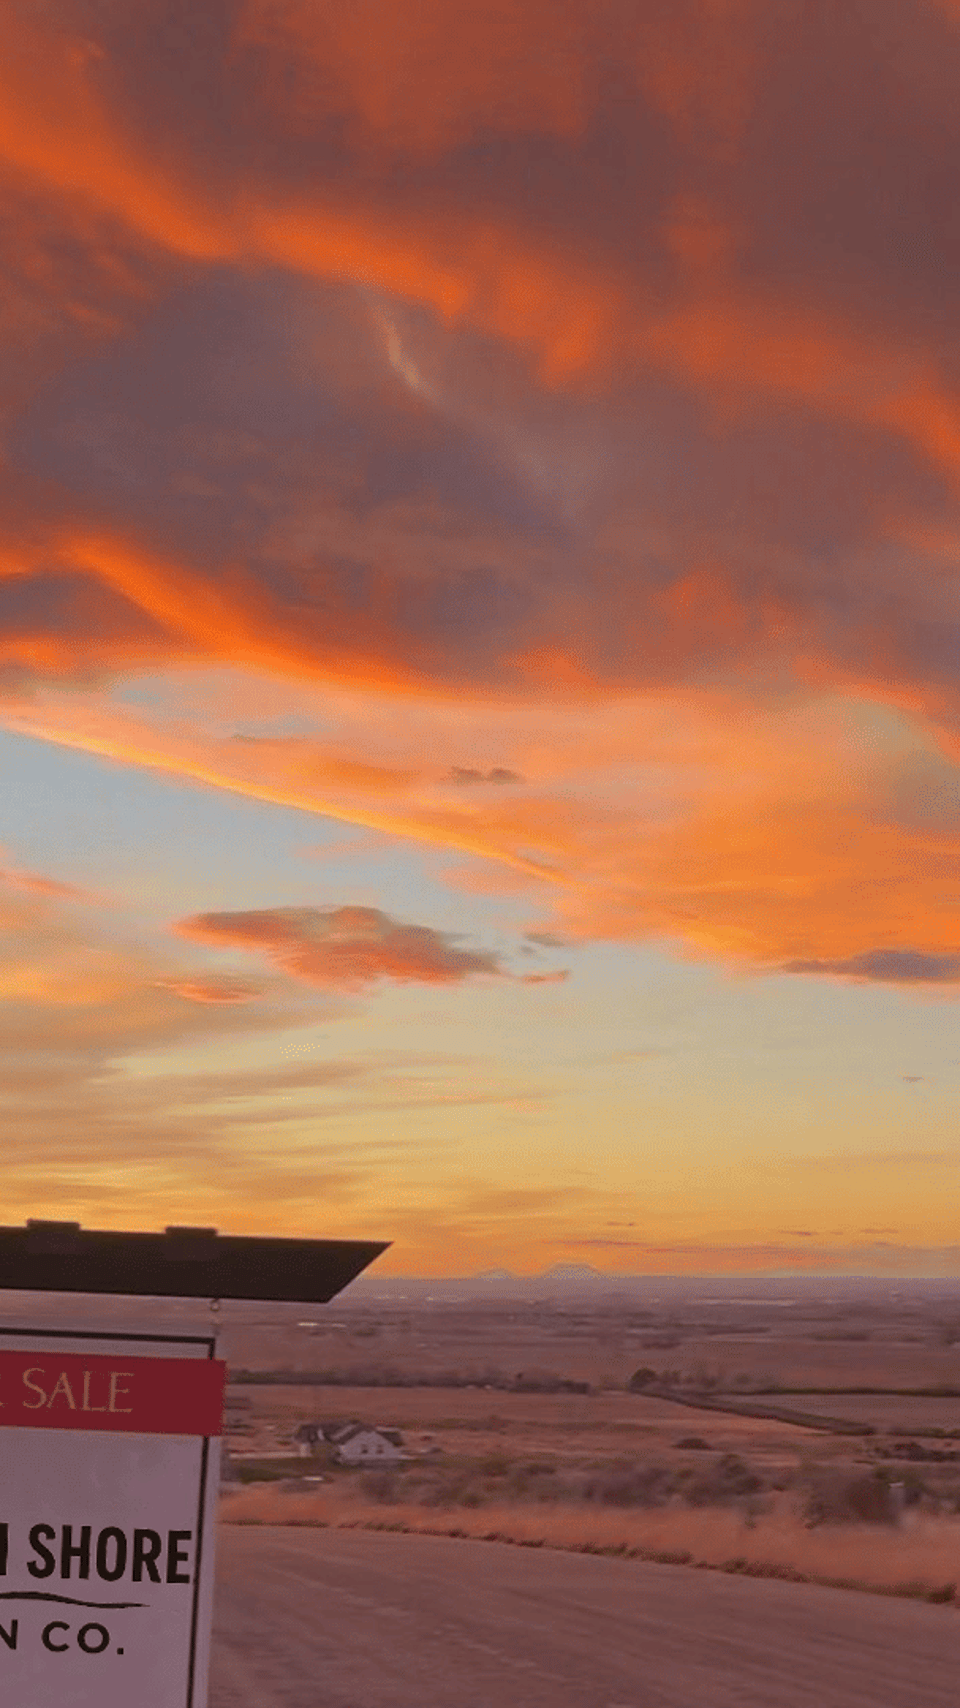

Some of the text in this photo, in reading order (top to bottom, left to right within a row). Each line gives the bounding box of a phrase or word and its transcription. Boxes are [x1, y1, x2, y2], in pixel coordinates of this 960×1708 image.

[22, 1368, 134, 1413] SALE
[26, 1524, 193, 1584] SHORE
[41, 1621, 125, 1655] CO.
